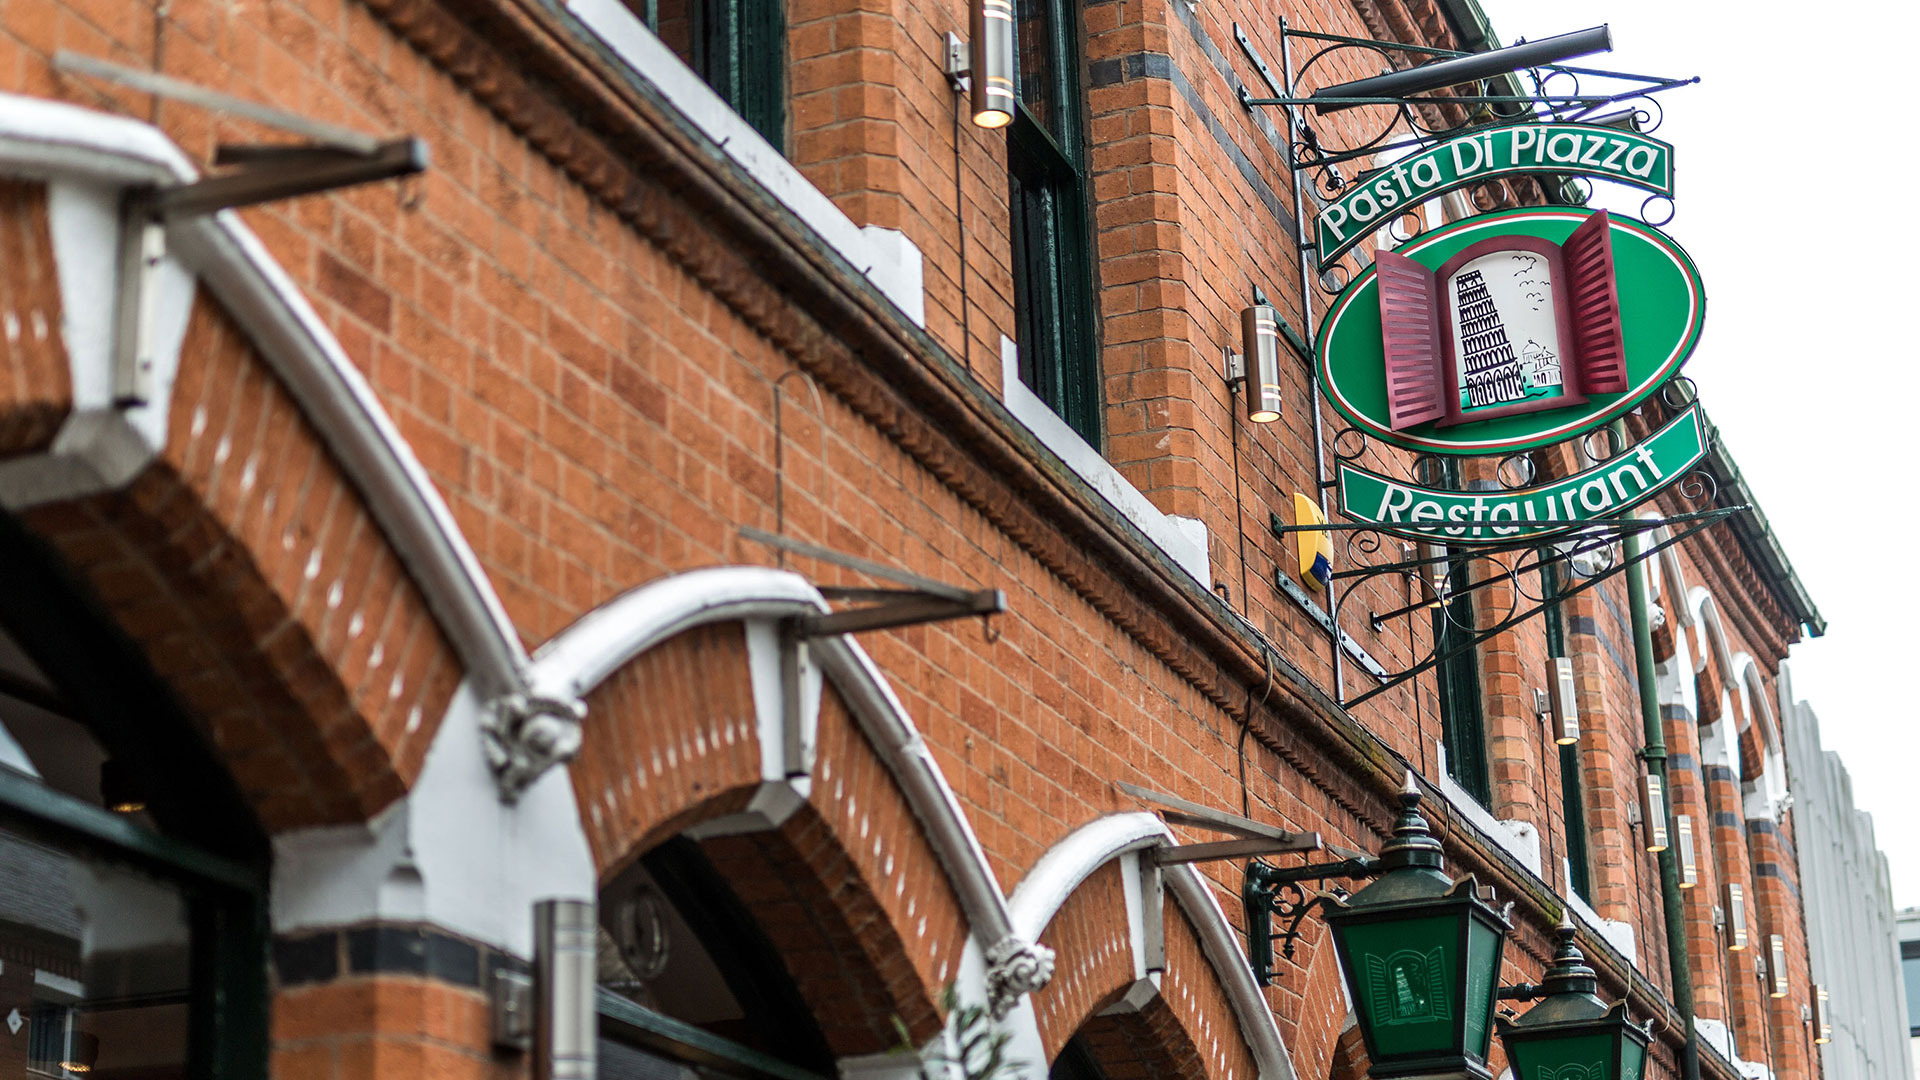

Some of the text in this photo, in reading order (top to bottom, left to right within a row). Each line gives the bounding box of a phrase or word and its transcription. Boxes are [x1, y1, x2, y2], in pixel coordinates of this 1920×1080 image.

[1318, 126, 1659, 242] Pasta Di Piazza
[1375, 444, 1664, 536] Restaurant
